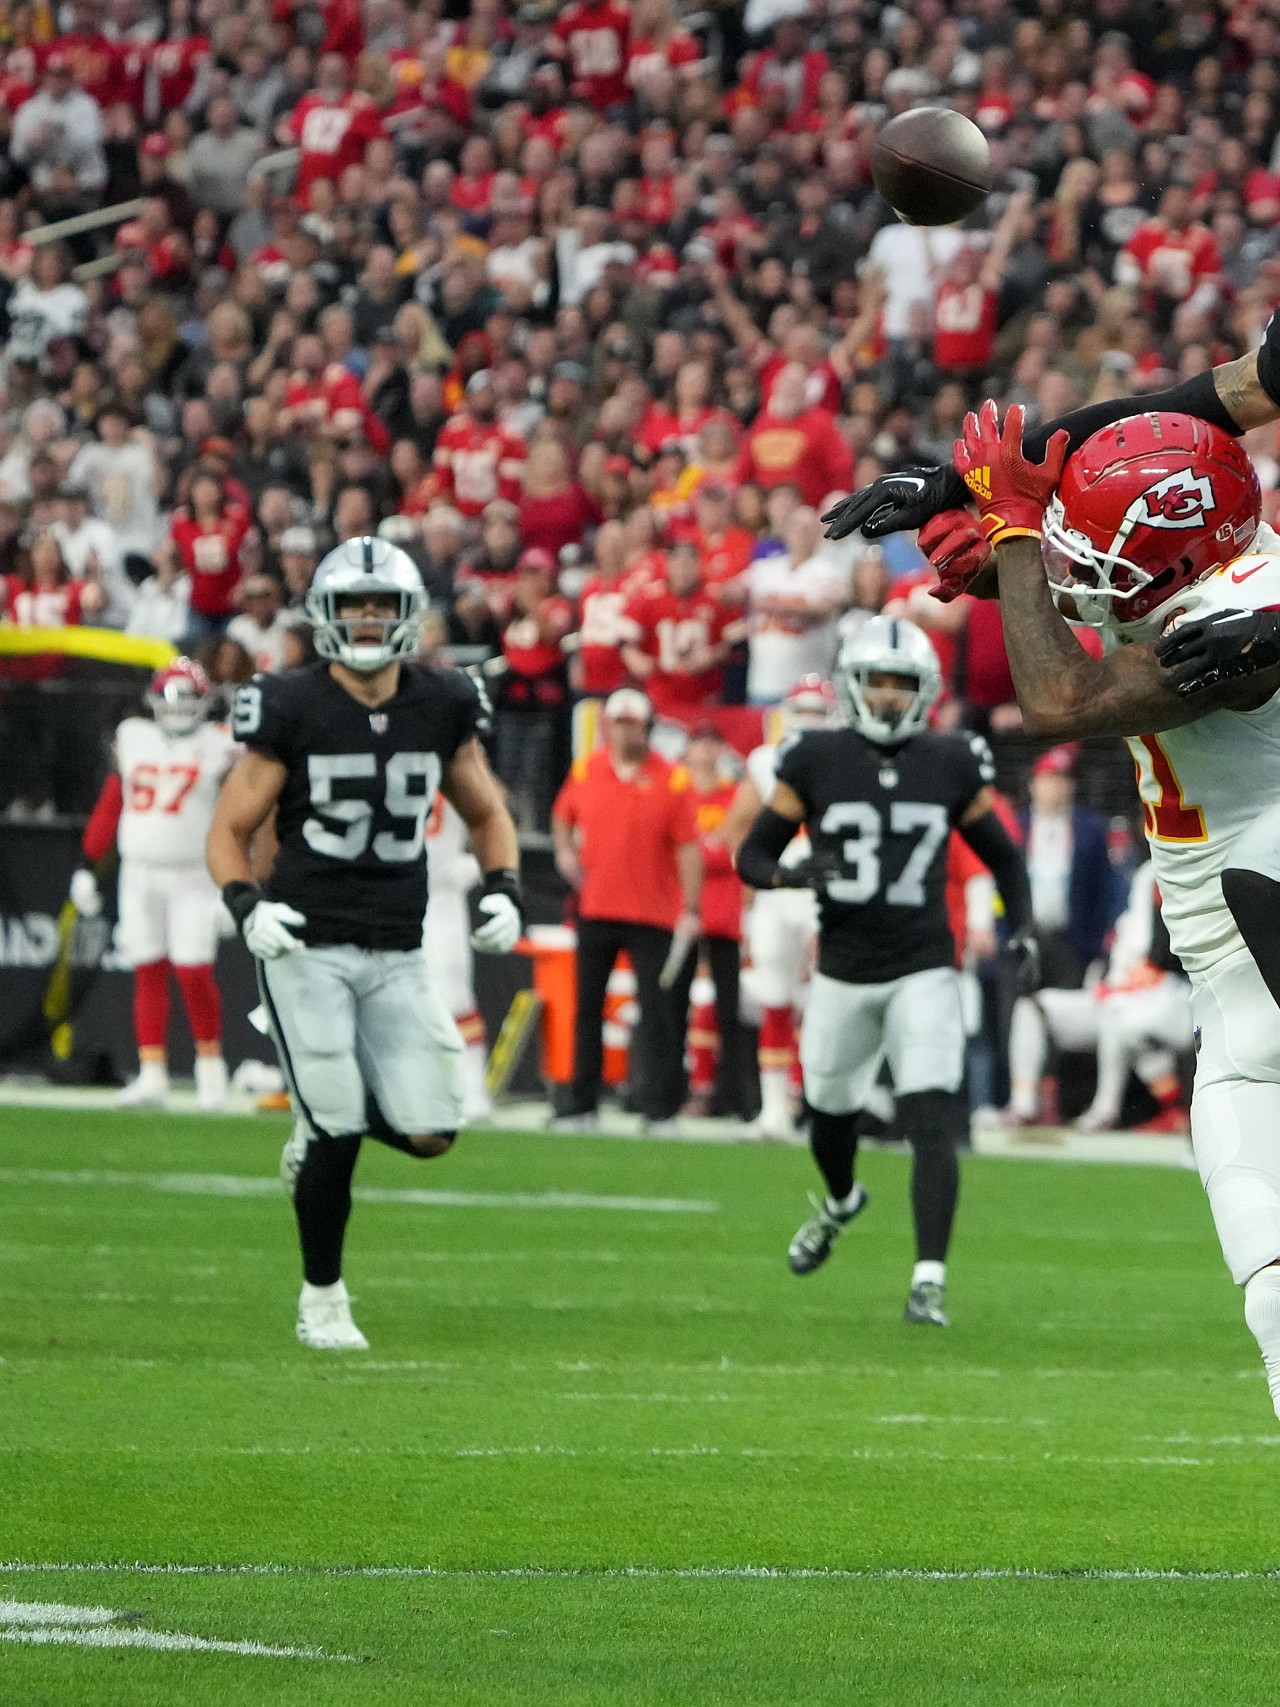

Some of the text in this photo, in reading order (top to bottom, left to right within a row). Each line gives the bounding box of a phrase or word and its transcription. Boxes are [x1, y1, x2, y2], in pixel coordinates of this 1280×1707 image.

[964, 473, 993, 500] adidas
[1142, 483, 1205, 521] KC
[131, 763, 200, 815] 67
[302, 751, 442, 861] 59
[820, 801, 949, 906] 37
